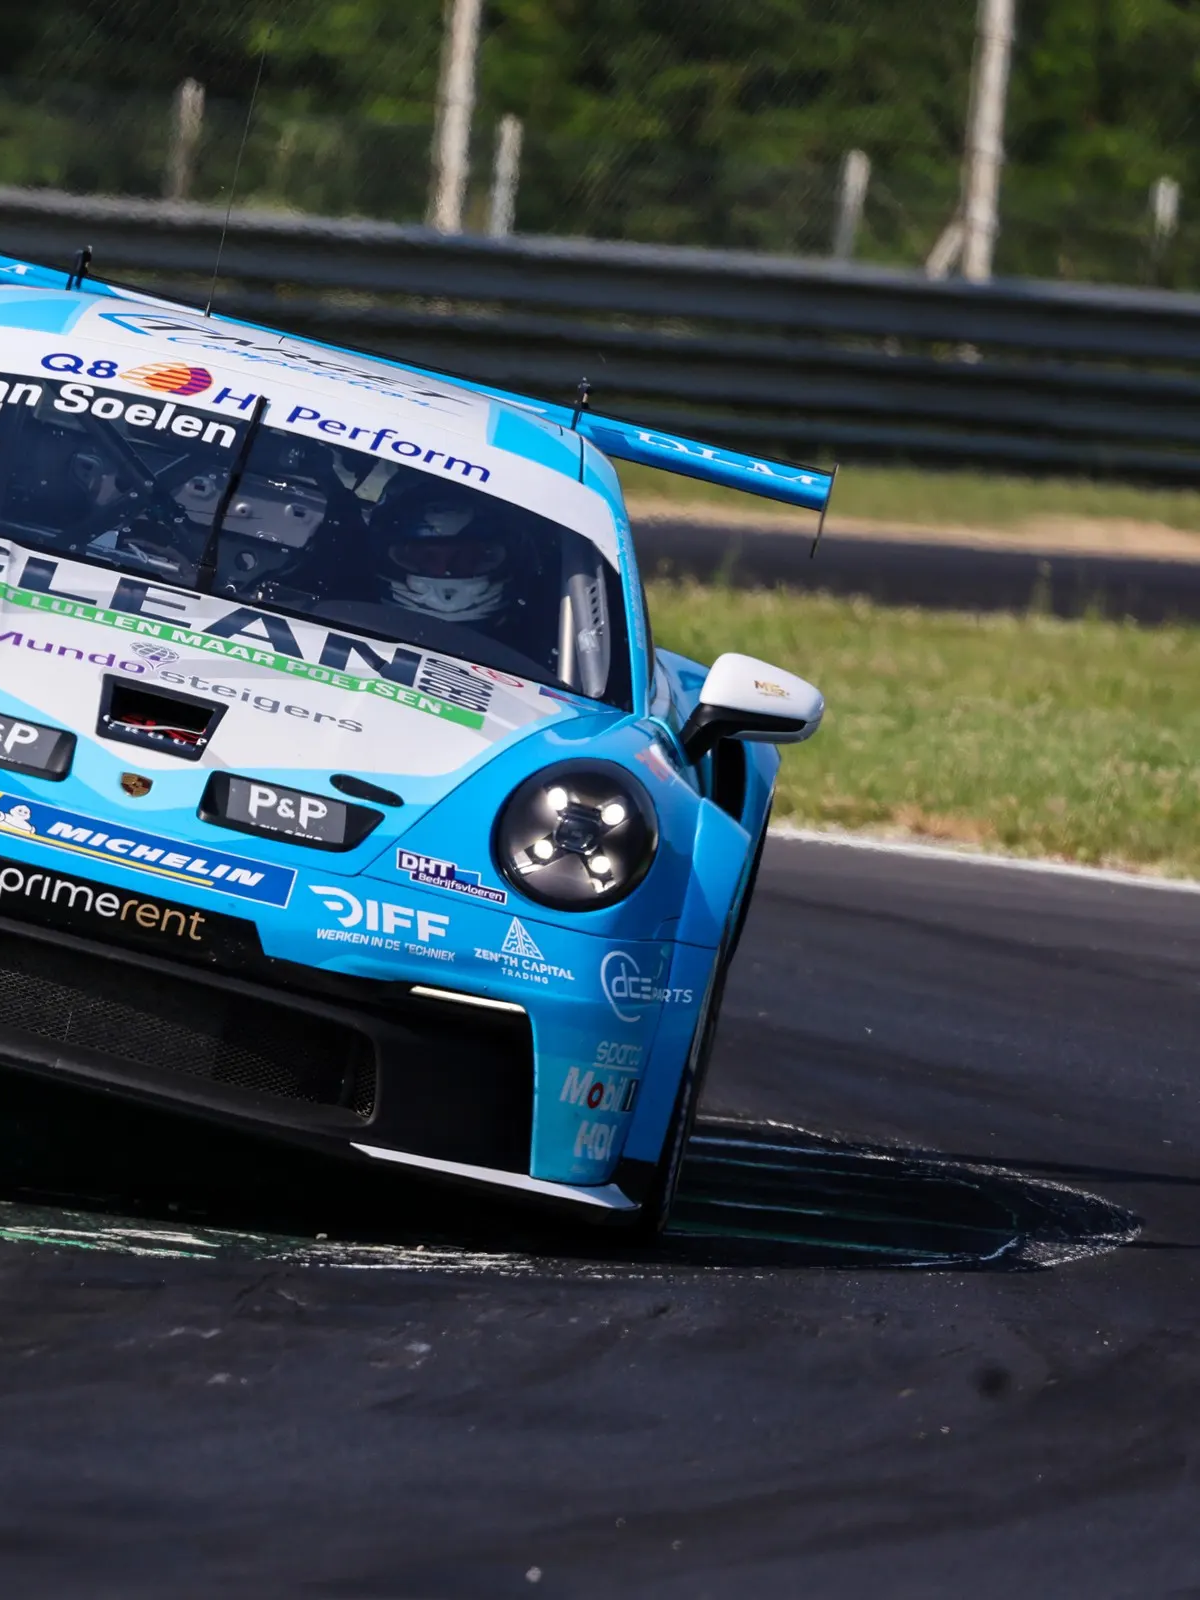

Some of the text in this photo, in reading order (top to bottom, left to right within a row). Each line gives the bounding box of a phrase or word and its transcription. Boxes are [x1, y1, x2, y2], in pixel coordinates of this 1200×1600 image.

[41, 352, 119, 379] Q8
[285, 404, 491, 483] Perform
[53, 383, 237, 448] Soelen
[30, 595, 167, 637] LULLEN
[171, 628, 285, 666] MAAR
[158, 669, 364, 733] steigers
[247, 783, 328, 831] P&P
[46, 821, 266, 887] MICHELIN
[401, 852, 453, 878] DHT
[418, 872, 503, 901] Bedrijfsvloeren
[308, 884, 450, 942] DIFF
[316, 927, 370, 946] WERKEN
[370, 934, 383, 948] IN
[384, 937, 401, 951] DE
[501, 967, 549, 985] TRADING
[522, 959, 575, 981] CAPITAL
[651, 987, 693, 1004] PARTS
[559, 1066, 626, 1112] Mobil
